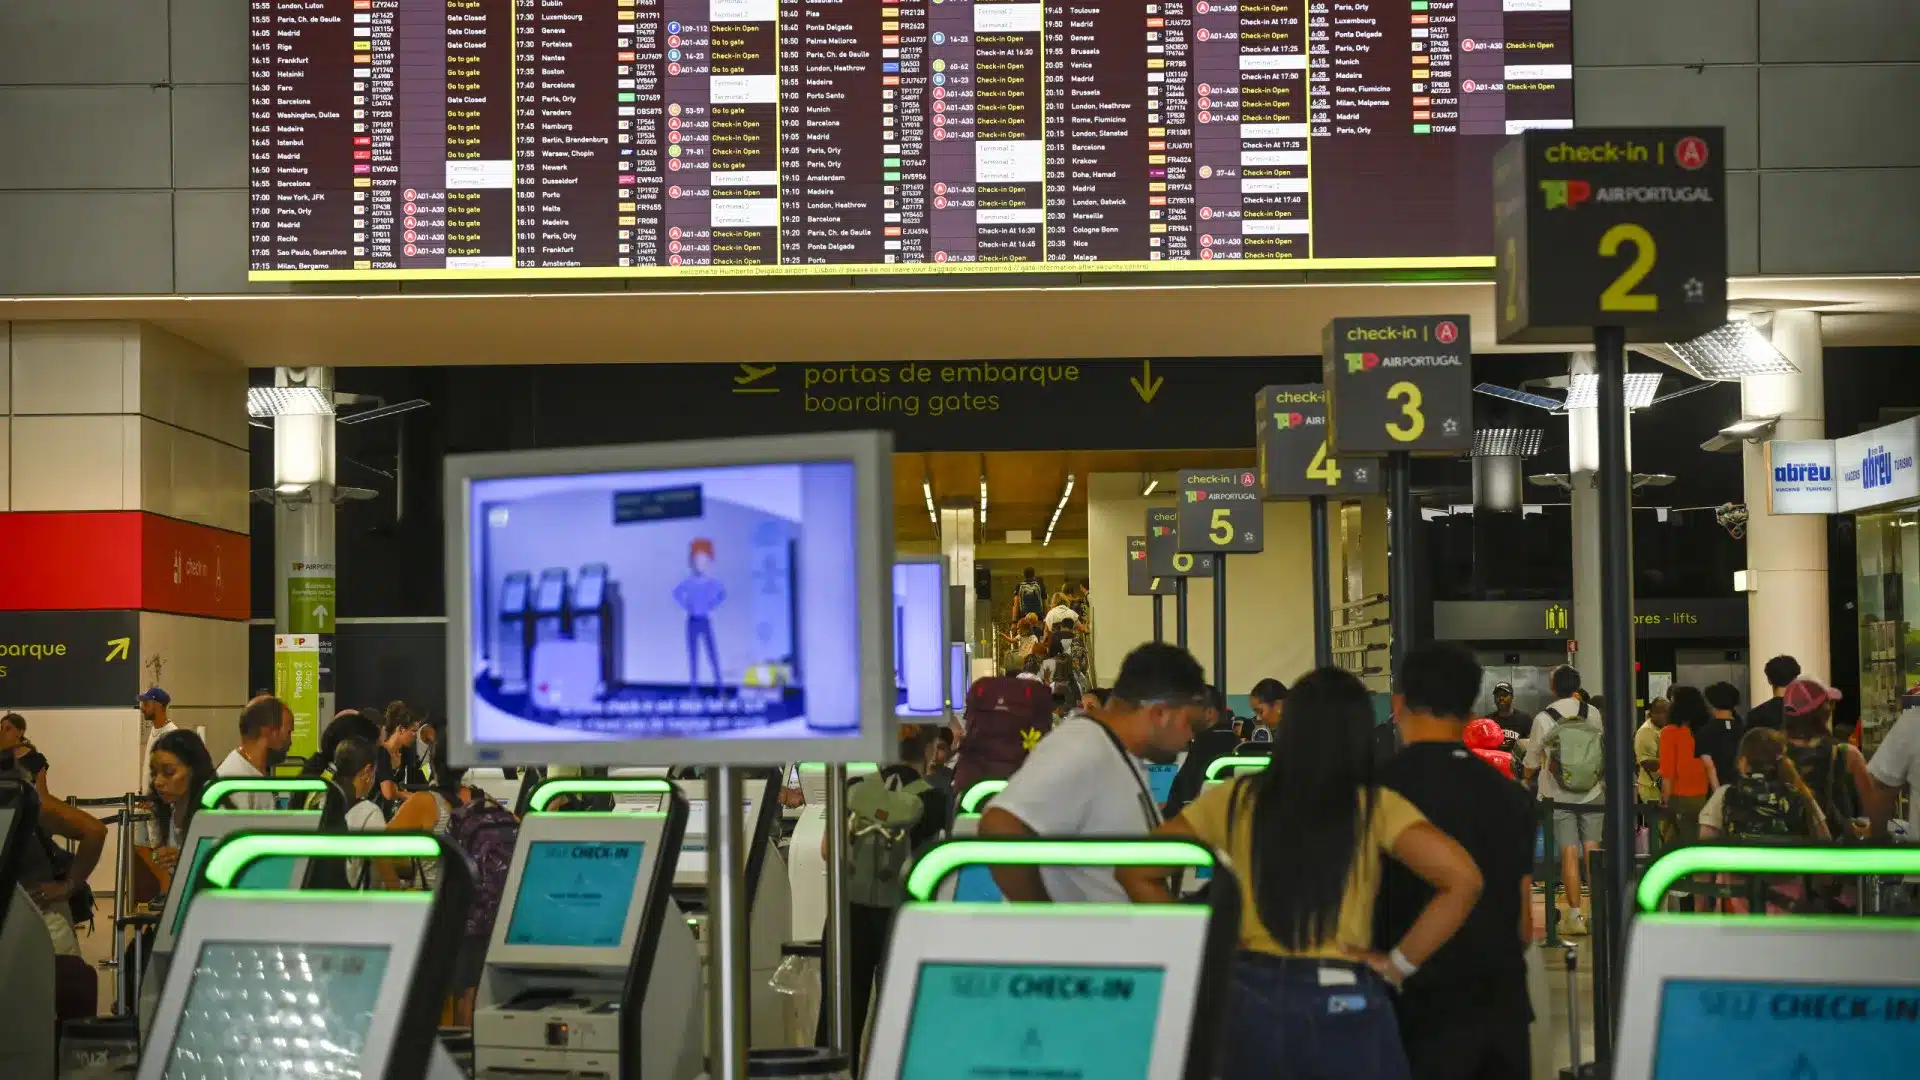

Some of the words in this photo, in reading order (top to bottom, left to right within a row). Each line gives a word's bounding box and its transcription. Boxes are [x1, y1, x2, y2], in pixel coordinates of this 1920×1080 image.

[826, 24, 853, 32] Delgada
[1545, 142, 1648, 163] check-in
[1598, 223, 1658, 311] 2
[1347, 325, 1416, 341] check-in
[804, 364, 891, 388] portas
[900, 362, 932, 383] de
[940, 362, 1080, 388] embarque
[804, 392, 919, 416] boarding
[929, 394, 1000, 416] gates
[1276, 390, 1325, 403] check-i
[1385, 381, 1425, 442] 3
[1306, 440, 1341, 486] 4
[1775, 463, 1831, 482] abreu
[1862, 448, 1892, 489] abreu
[1187, 475, 1230, 484] check-in
[1208, 508, 1234, 545] 5
[1632, 613, 1660, 624] ores
[1673, 612, 1697, 624] lifts
[571, 846, 629, 859] CHECK-IN
[1008, 974, 1135, 1000] CHECK-IN
